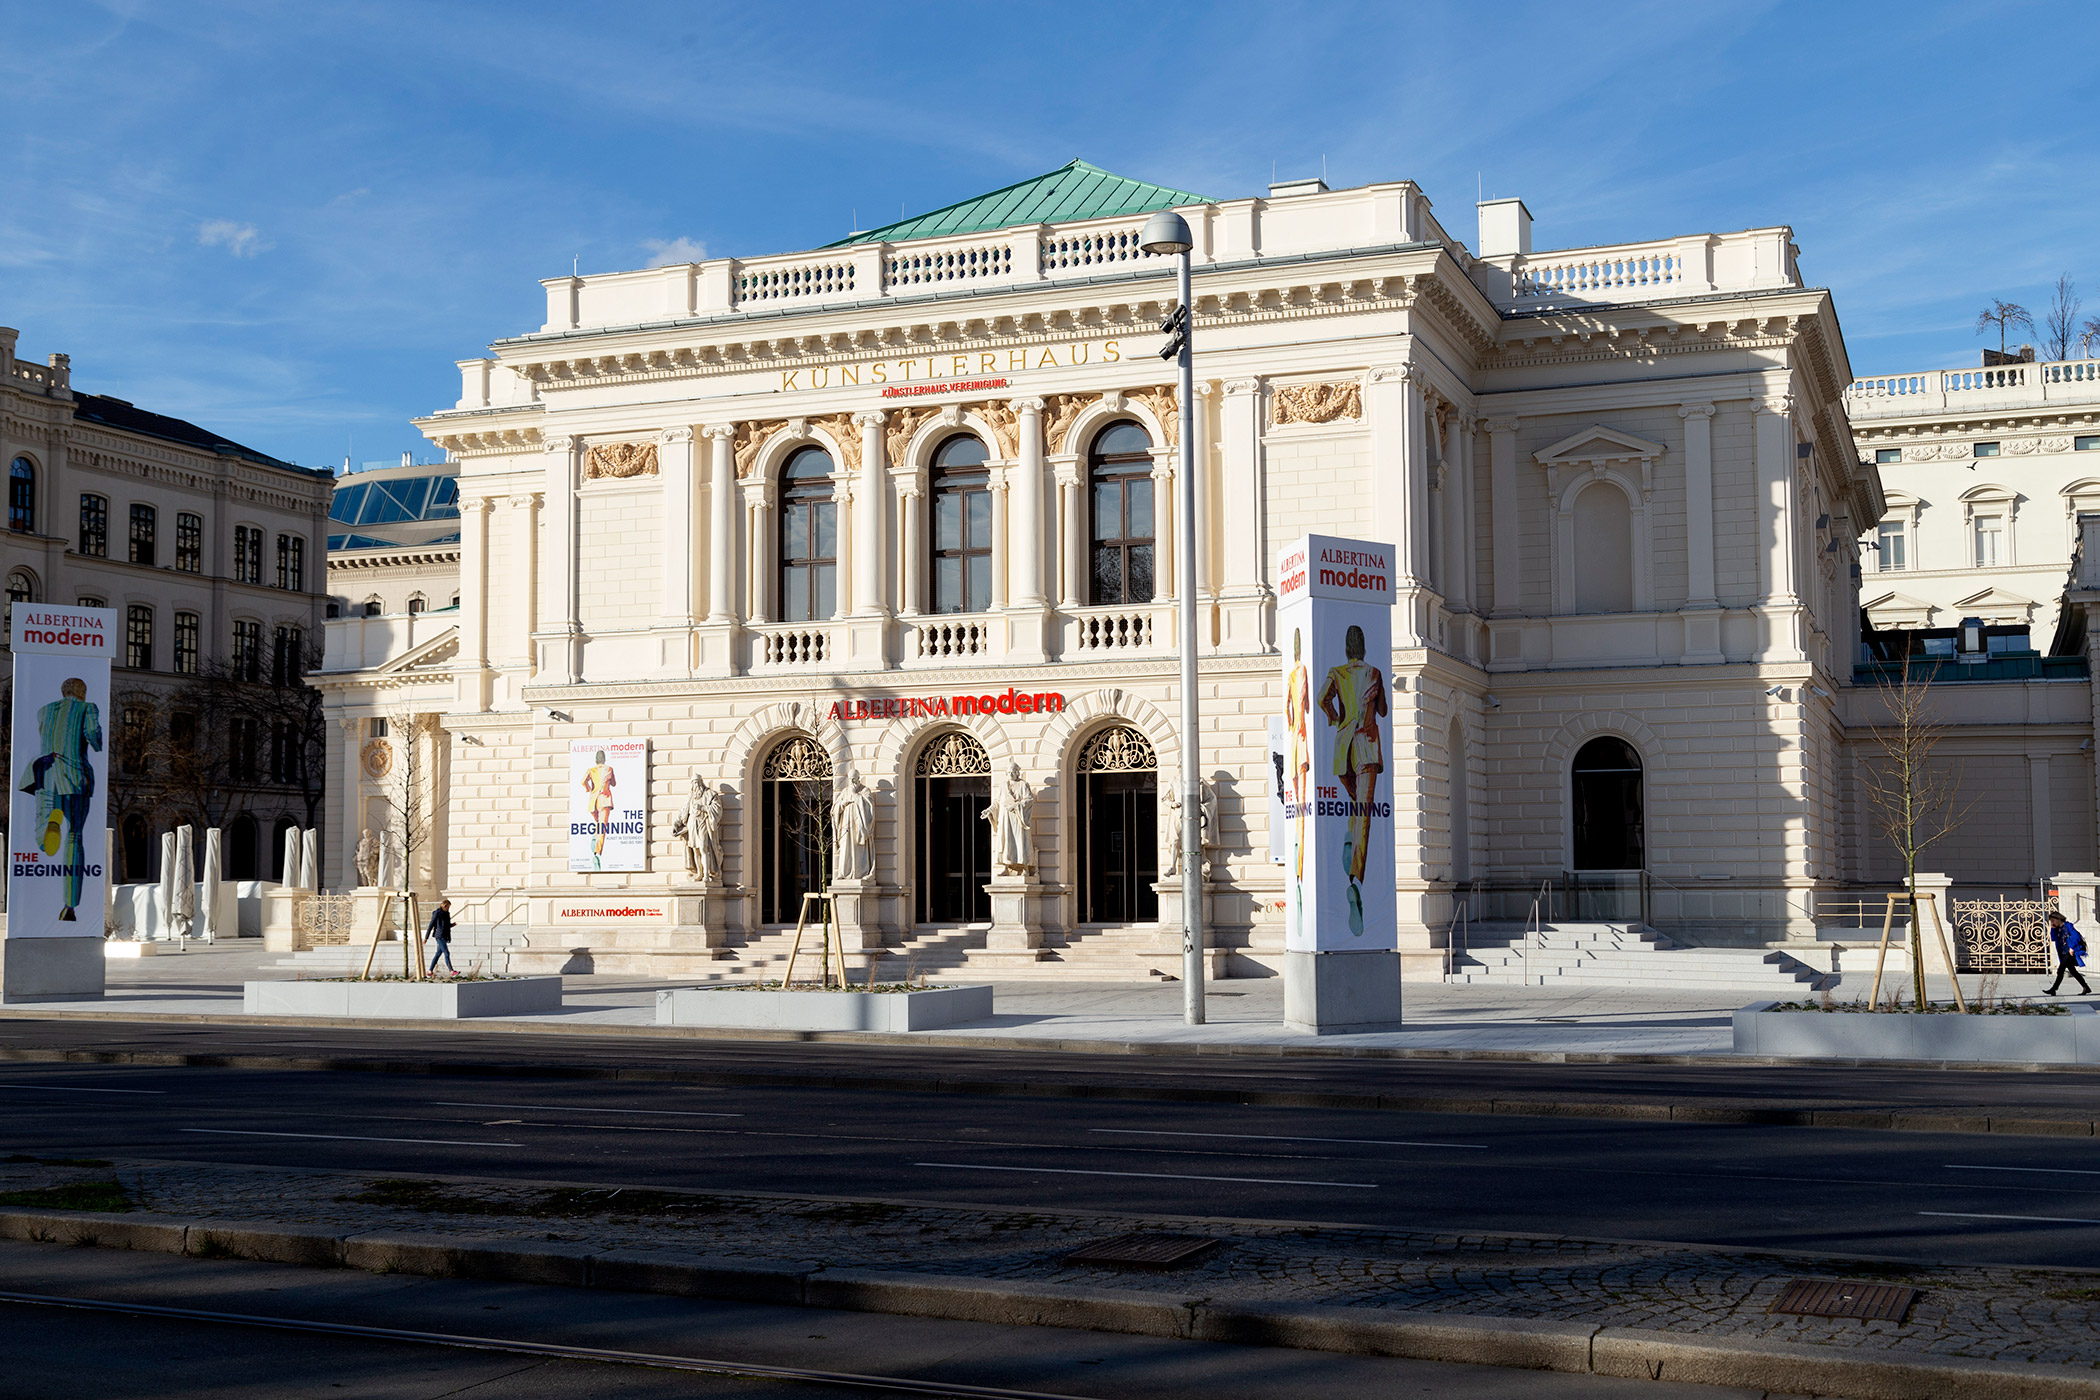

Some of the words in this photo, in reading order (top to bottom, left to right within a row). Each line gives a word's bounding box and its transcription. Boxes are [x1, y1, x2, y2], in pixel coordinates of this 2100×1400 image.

[781, 341, 1120, 391] KÜNSTLERHAUS
[881, 383, 948, 398] KÜNSTLERHAUS
[949, 378, 1006, 391] VEREINIGUNG
[1281, 549, 1305, 574] ALBERTINA
[1320, 548, 1386, 569] ALBERTINA
[1281, 570, 1306, 597] modern
[1320, 568, 1386, 592] modern
[25, 613, 103, 629] ALBERTINA
[24, 628, 104, 647] modern
[827, 696, 949, 720] ALBERTINA
[952, 688, 1062, 715] modern
[572, 744, 611, 753] ALBERTINA
[610, 742, 645, 752] modern
[1285, 790, 1293, 802] THE
[1317, 786, 1338, 799] THE
[623, 810, 644, 820] THE
[1317, 801, 1391, 818] BEGINNING
[571, 821, 644, 835] BEGINNING
[13, 852, 39, 863] THE
[13, 864, 102, 877] BEGINNING
[561, 908, 605, 917] ALBERTINA
[605, 906, 645, 917] modern
